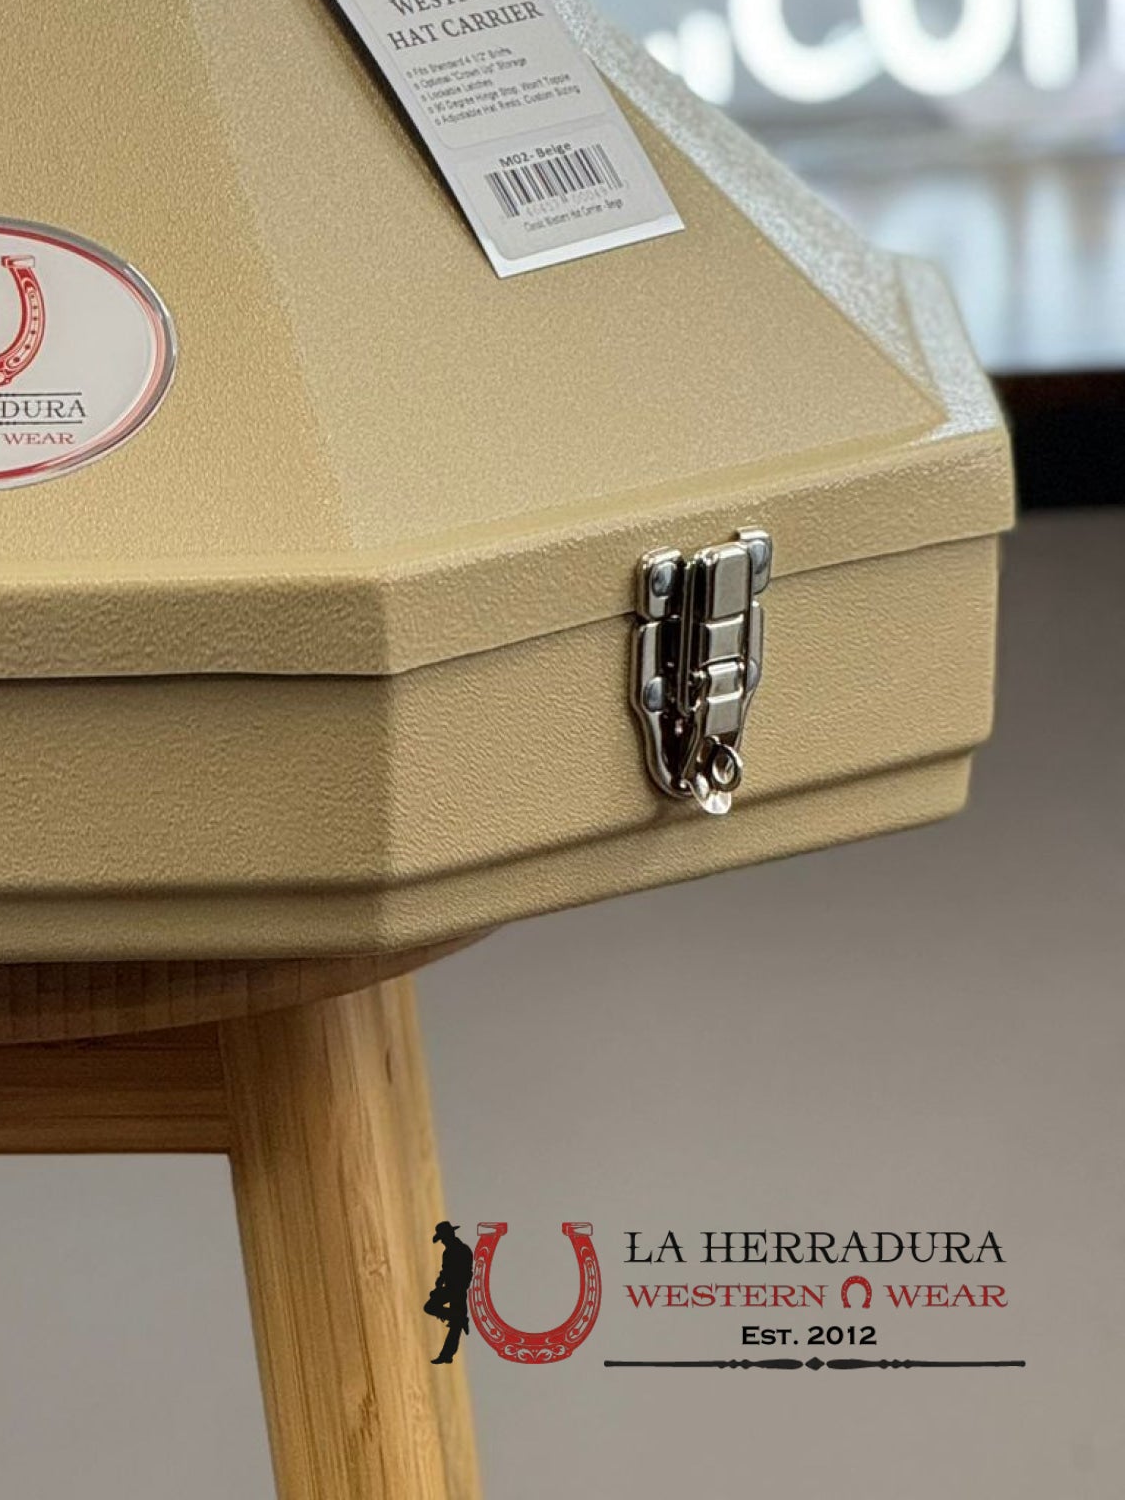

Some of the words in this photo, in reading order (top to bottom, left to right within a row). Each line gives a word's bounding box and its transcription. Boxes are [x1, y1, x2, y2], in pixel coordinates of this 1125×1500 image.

[387, 23, 439, 50] HAT
[441, 0, 545, 37] CARRIER
[535, 141, 573, 158] Beige
[1, 432, 75, 445] WEAR
